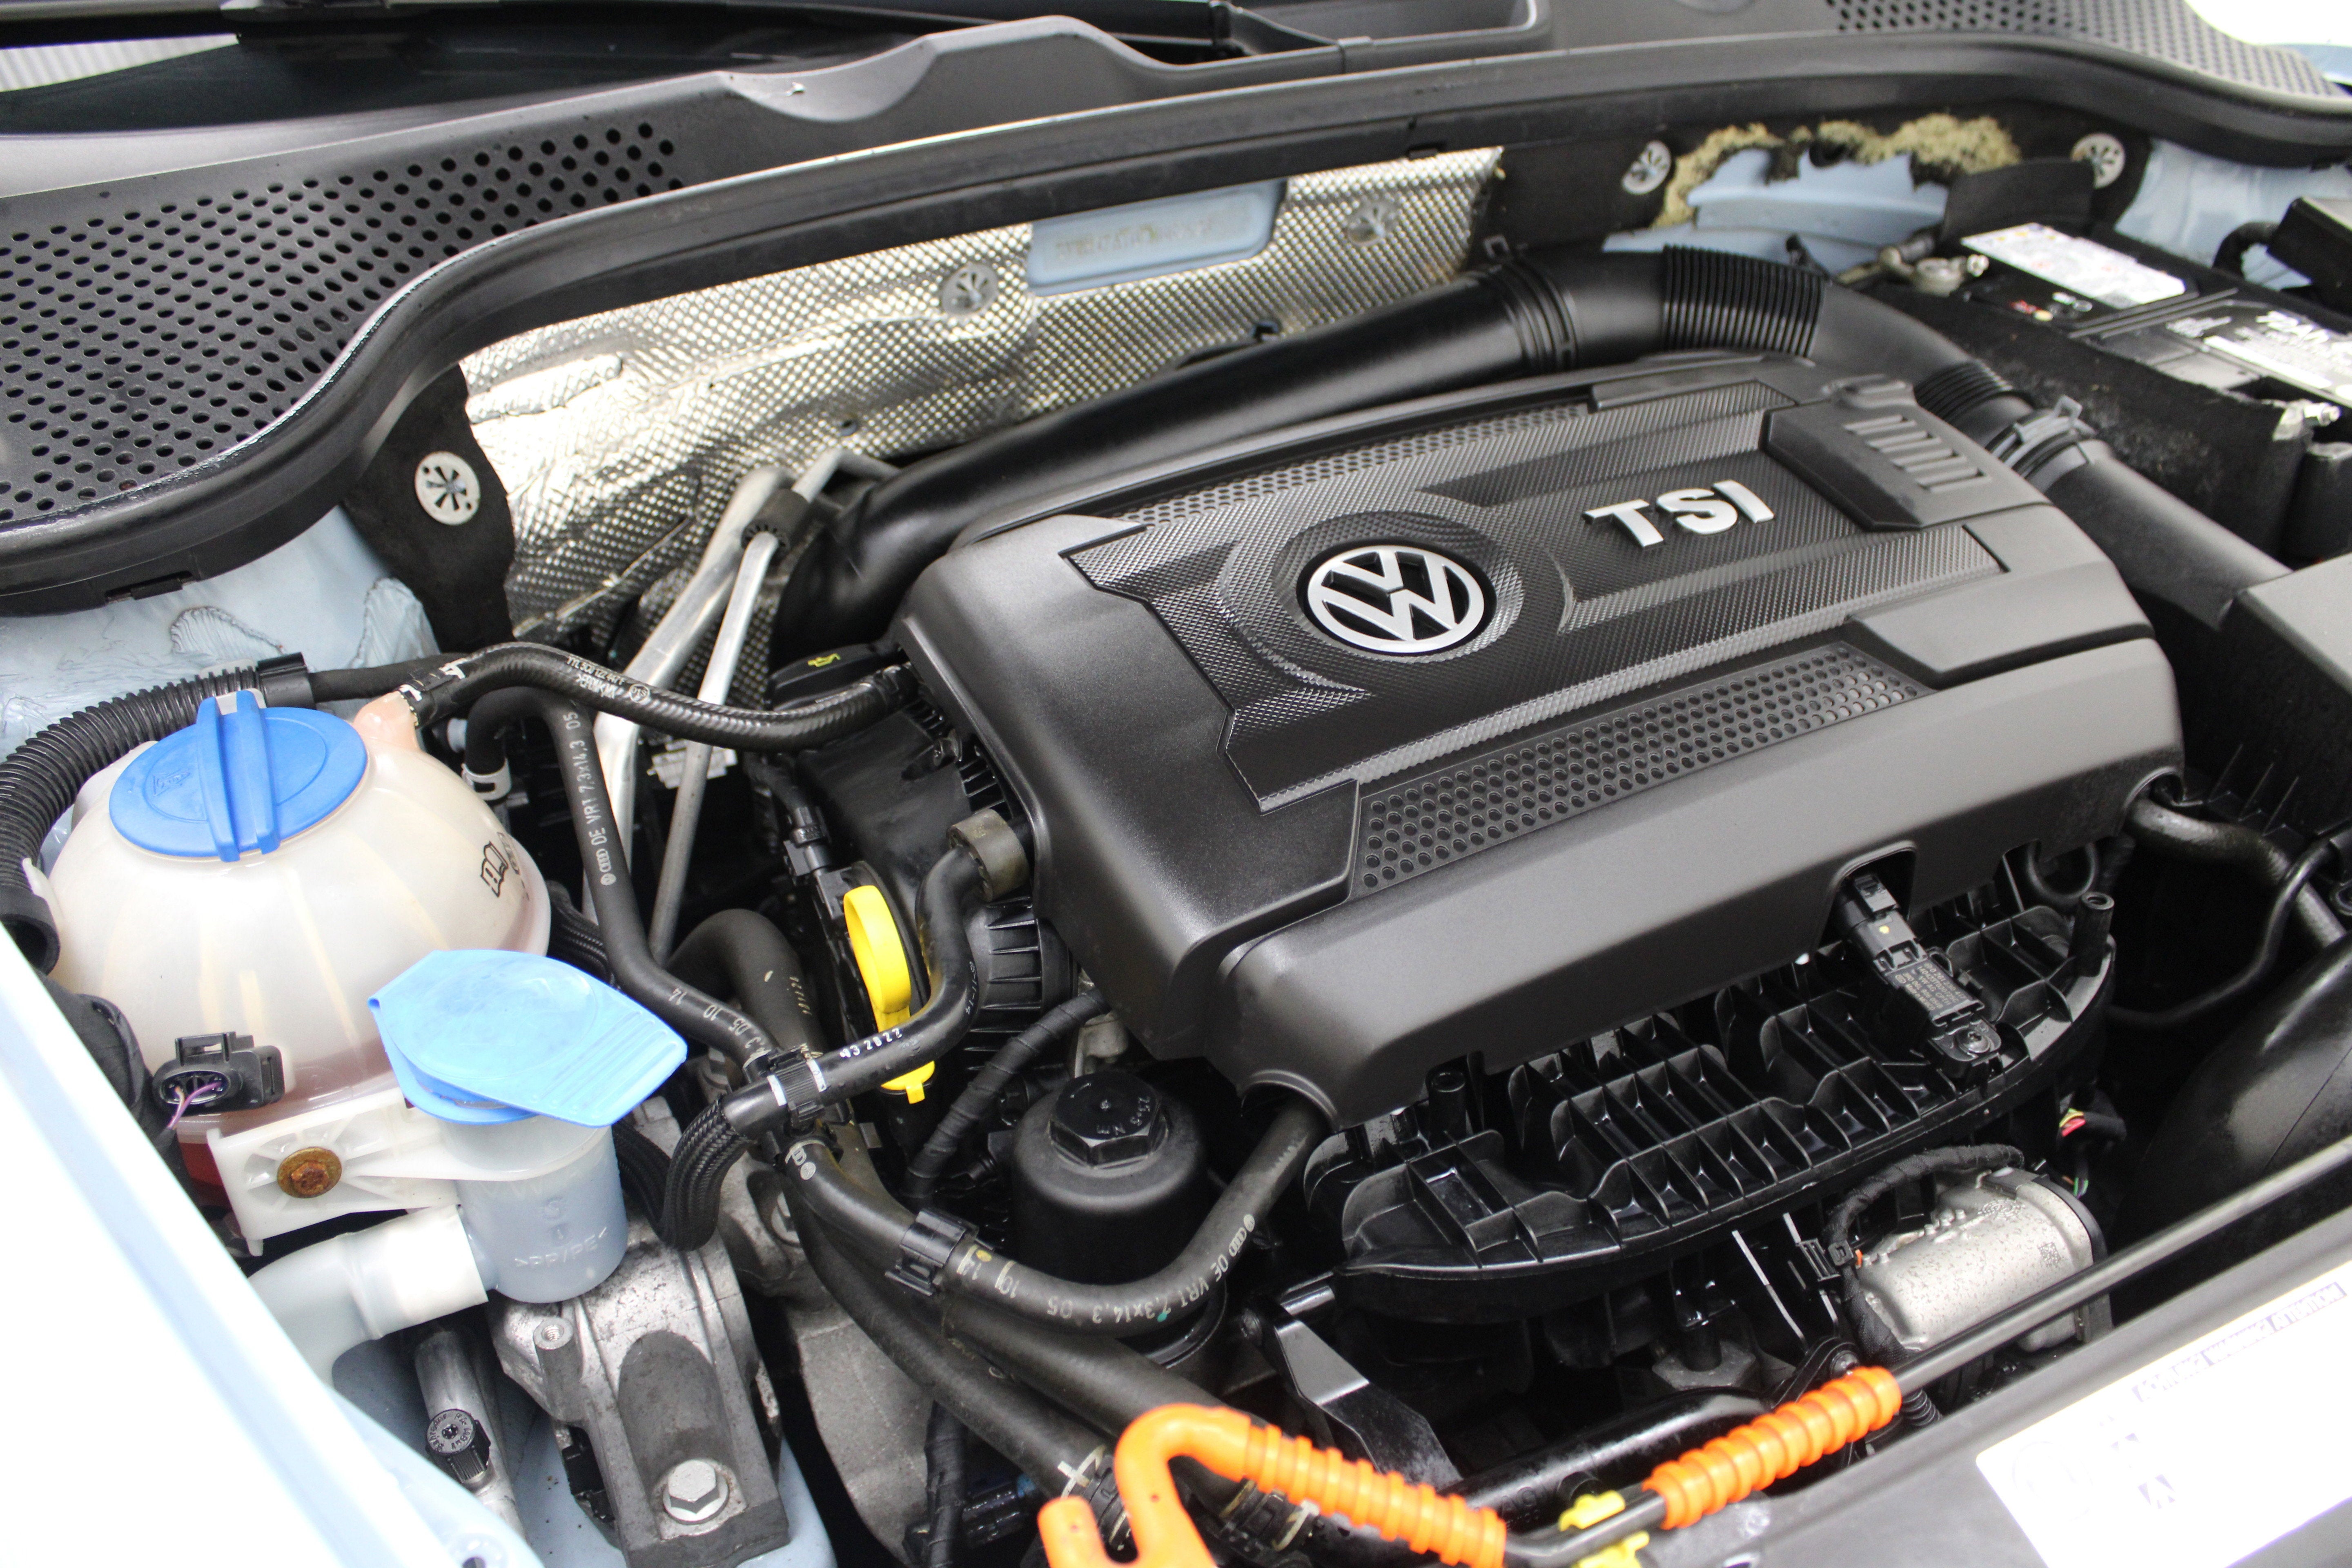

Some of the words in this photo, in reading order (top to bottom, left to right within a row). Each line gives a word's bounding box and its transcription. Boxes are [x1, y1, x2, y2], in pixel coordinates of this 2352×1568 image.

[1582, 479, 1774, 547] TSI
[1307, 545, 1484, 653] VW
[563, 712, 581, 730] 05
[581, 798, 602, 824] VRT
[669, 986, 687, 1005] 14
[703, 1005, 723, 1021] 10
[728, 1018, 751, 1036] 05
[999, 1276, 1020, 1299] 10
[1178, 1277, 1209, 1307] VRT
[1047, 1296, 1073, 1319] 05
